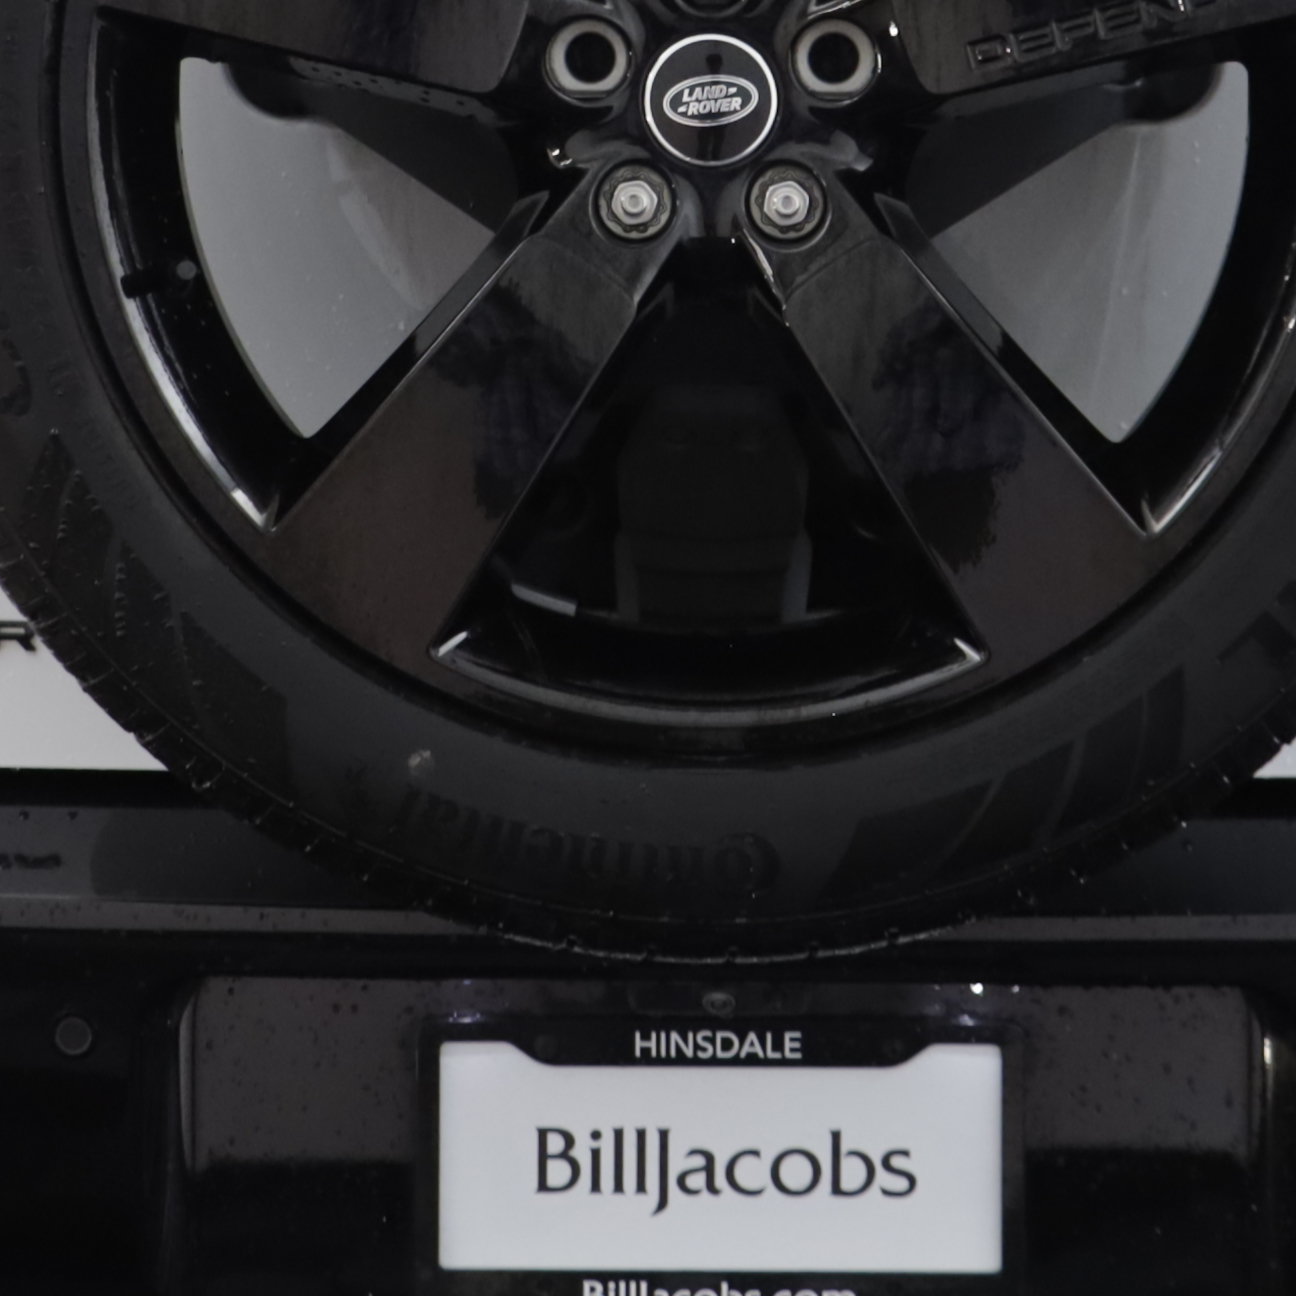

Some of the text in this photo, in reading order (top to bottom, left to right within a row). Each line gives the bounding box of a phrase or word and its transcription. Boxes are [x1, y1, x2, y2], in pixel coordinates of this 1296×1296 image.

[682, 85, 726, 102] LAND
[687, 96, 743, 116] ROVER
[633, 1030, 803, 1060] HINSDALE
